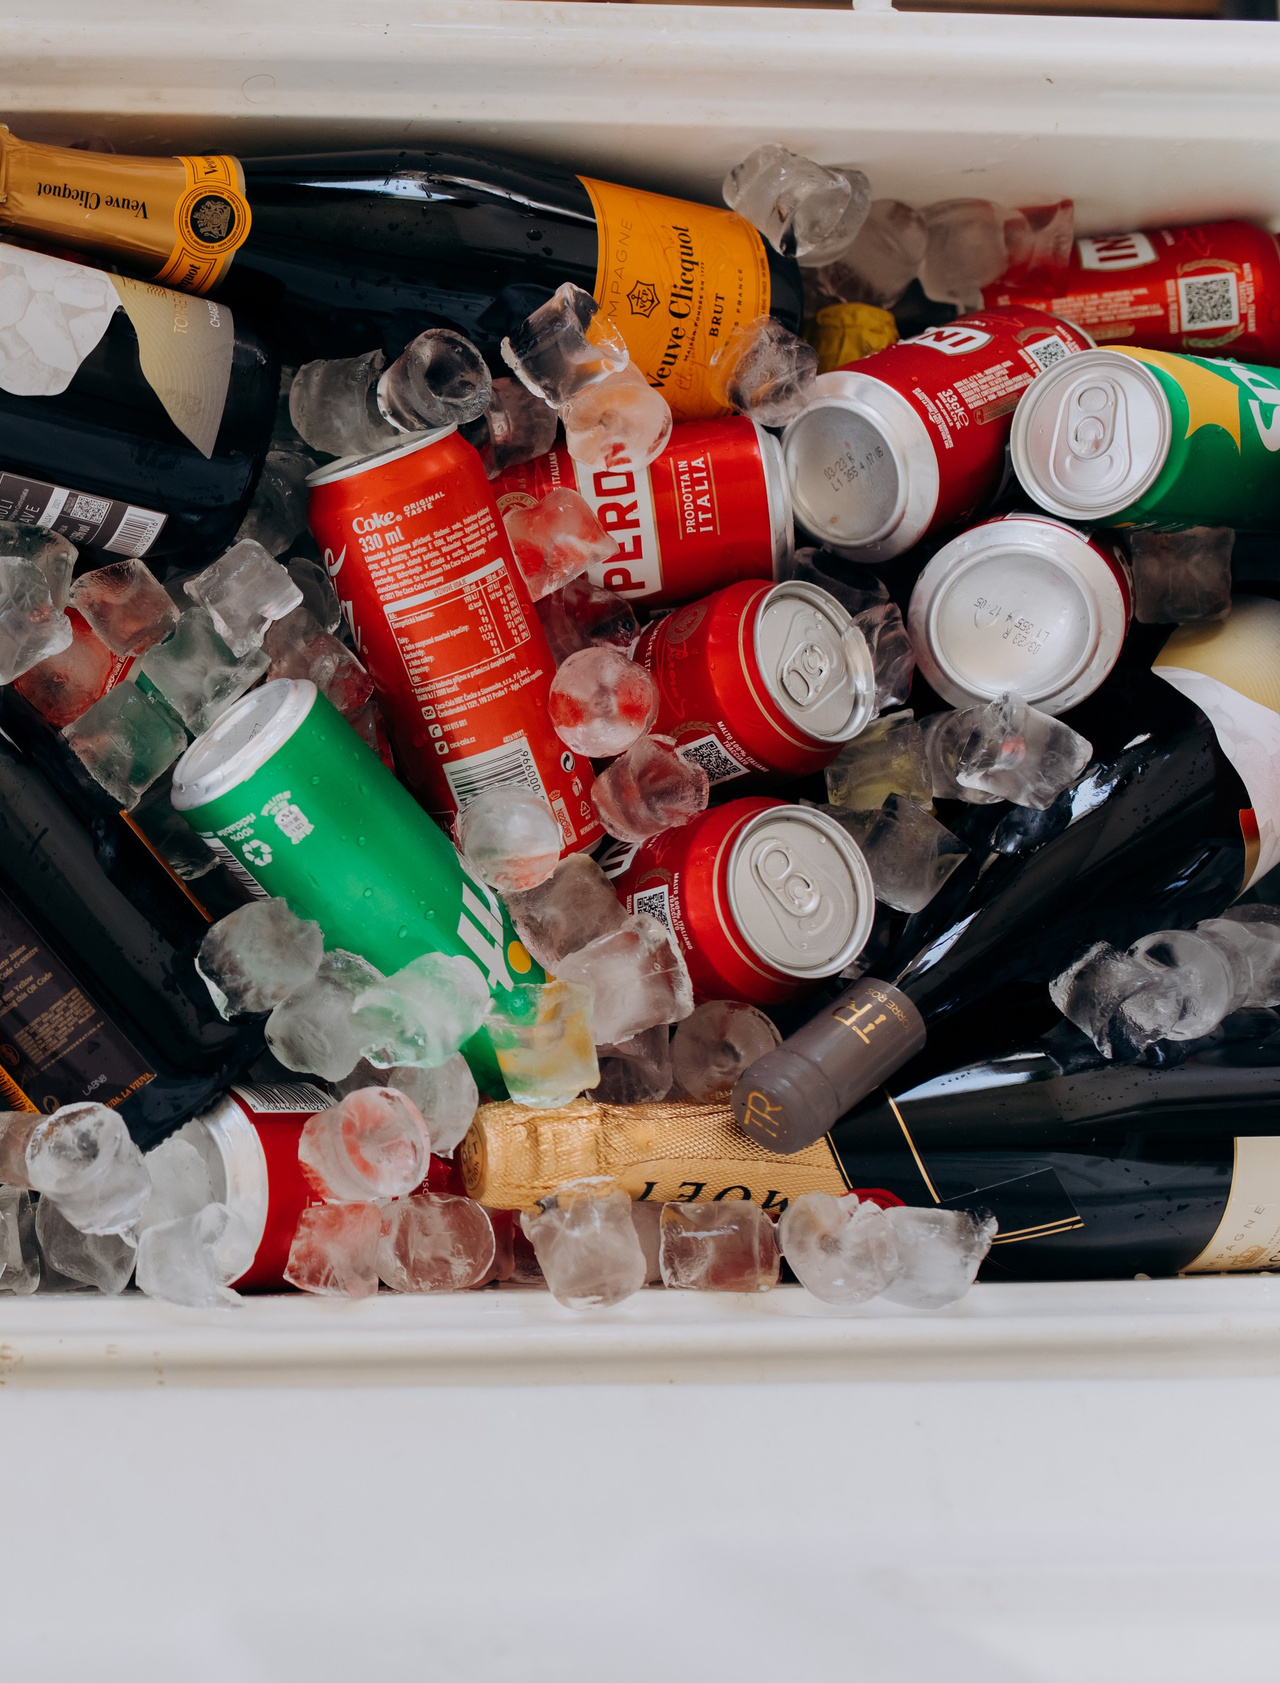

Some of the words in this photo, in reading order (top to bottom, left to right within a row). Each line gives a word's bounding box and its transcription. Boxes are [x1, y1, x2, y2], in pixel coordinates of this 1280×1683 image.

[35, 180, 101, 210] Clicquot
[104, 193, 150, 218] Veuve
[668, 225, 699, 319] Clicquot
[709, 293, 725, 338] BRUT
[678, 460, 688, 472] IN
[679, 473, 697, 534] PRODOTTA
[692, 456, 714, 533] ITALIA
[352, 510, 398, 535] Coke
[403, 491, 445, 513] ORIGINAL
[405, 502, 434, 518] TASTE
[358, 533, 383, 554] 330
[384, 526, 405, 546] ml
[449, 553, 470, 569] Coca-Cola
[402, 580, 424, 594] Coca-Cola
[423, 573, 444, 588] Company
[434, 697, 454, 712] Coca-Cola
[463, 688, 477, 701] Česko
[491, 687, 505, 700] Praha
[448, 734, 476, 750] coca-cola.cz
[716, 720, 733, 743] MALTO
[216, 812, 258, 838] riciclabile
[229, 825, 255, 843] 100%
[7, 942, 27, 961] Jaune
[11, 944, 40, 970] ci-contre
[13, 971, 35, 993] Yellow
[14, 988, 28, 1003] this
[25, 981, 38, 995] QR
[34, 968, 53, 987] Code
[81, 1072, 108, 1097] LABN8
[119, 1086, 133, 1099] LA
[129, 1069, 154, 1091] VIUVA.
[250, 1103, 257, 1111] 8
[743, 1090, 783, 1139] TR
